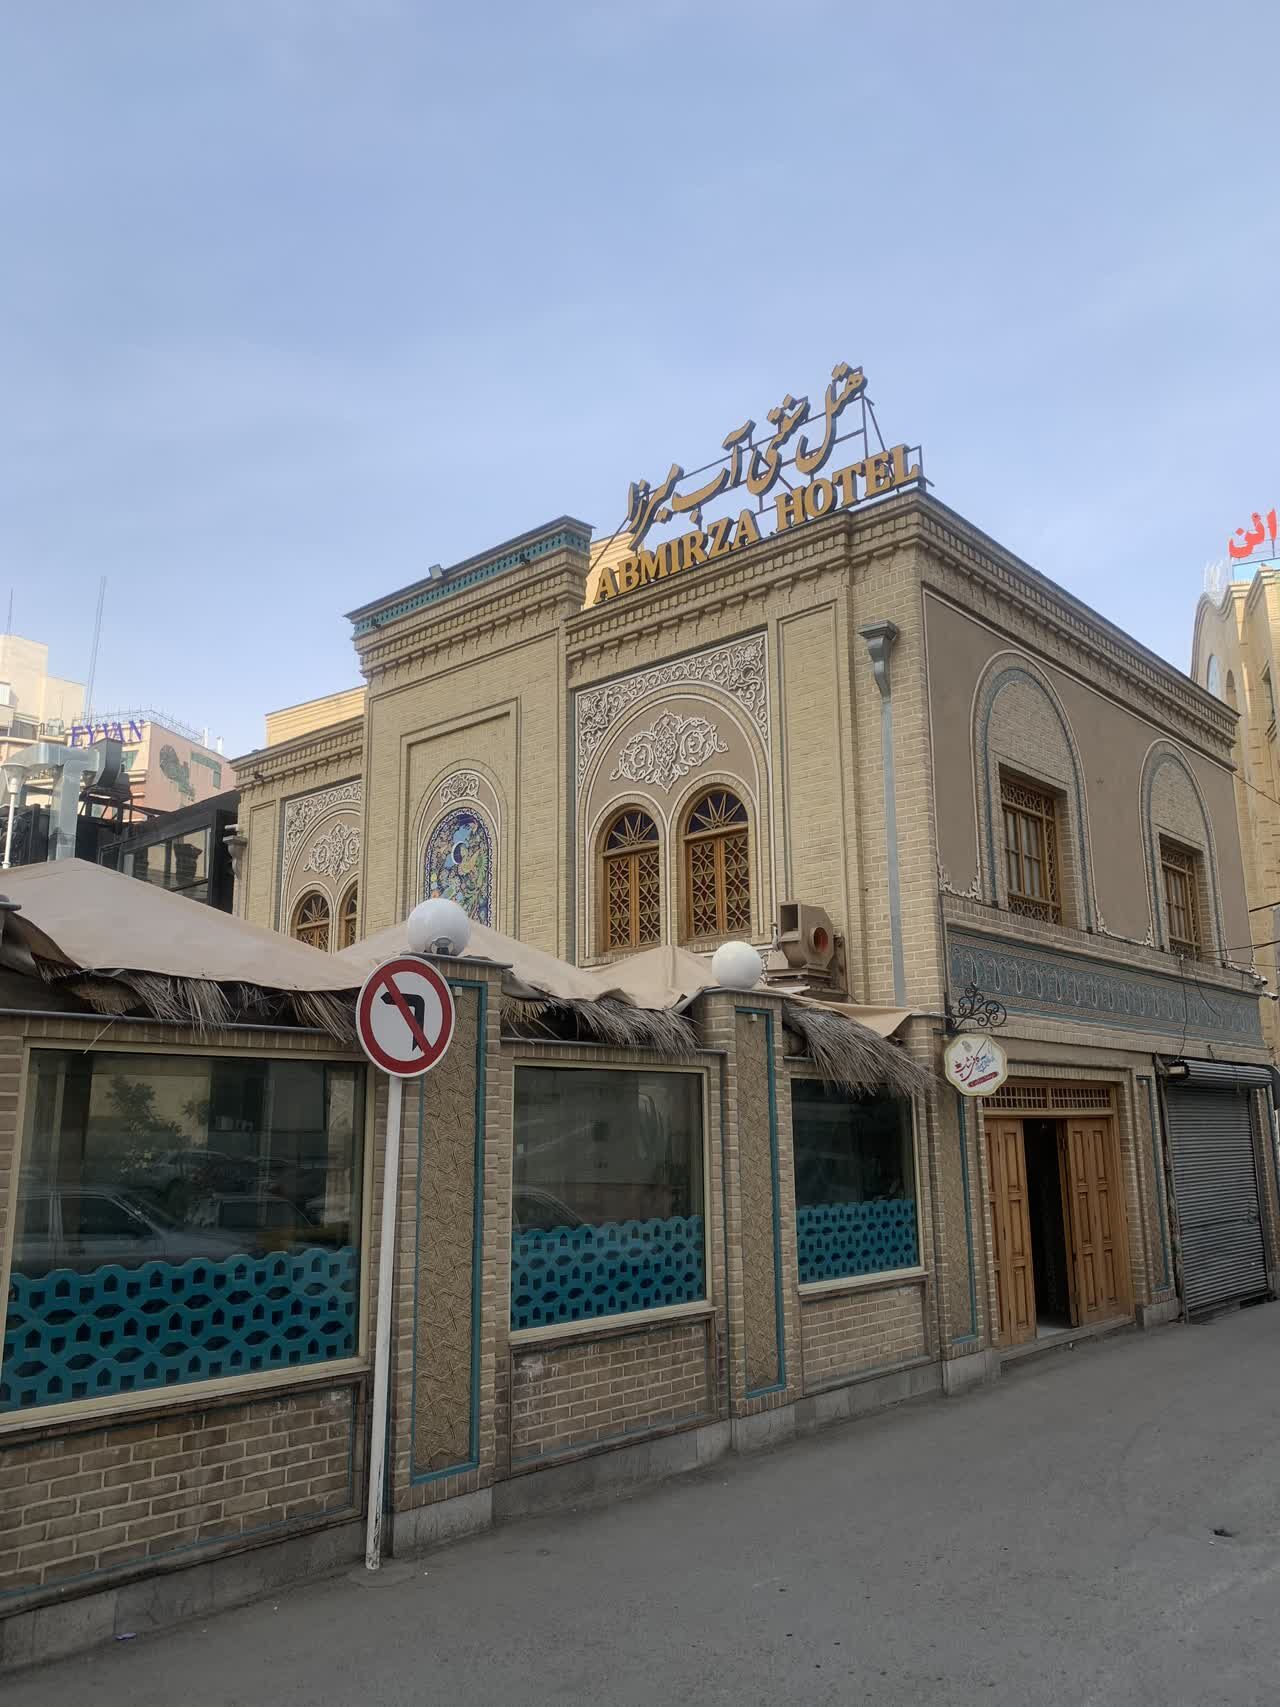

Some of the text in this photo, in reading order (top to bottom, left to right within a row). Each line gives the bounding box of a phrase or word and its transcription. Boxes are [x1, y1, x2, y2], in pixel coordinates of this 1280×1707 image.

[746, 393, 811, 496] سنتی
[796, 361, 868, 475] هتل
[593, 444, 920, 604] ABMIRZA HOTEL
[70, 719, 145, 749] EYVAN
